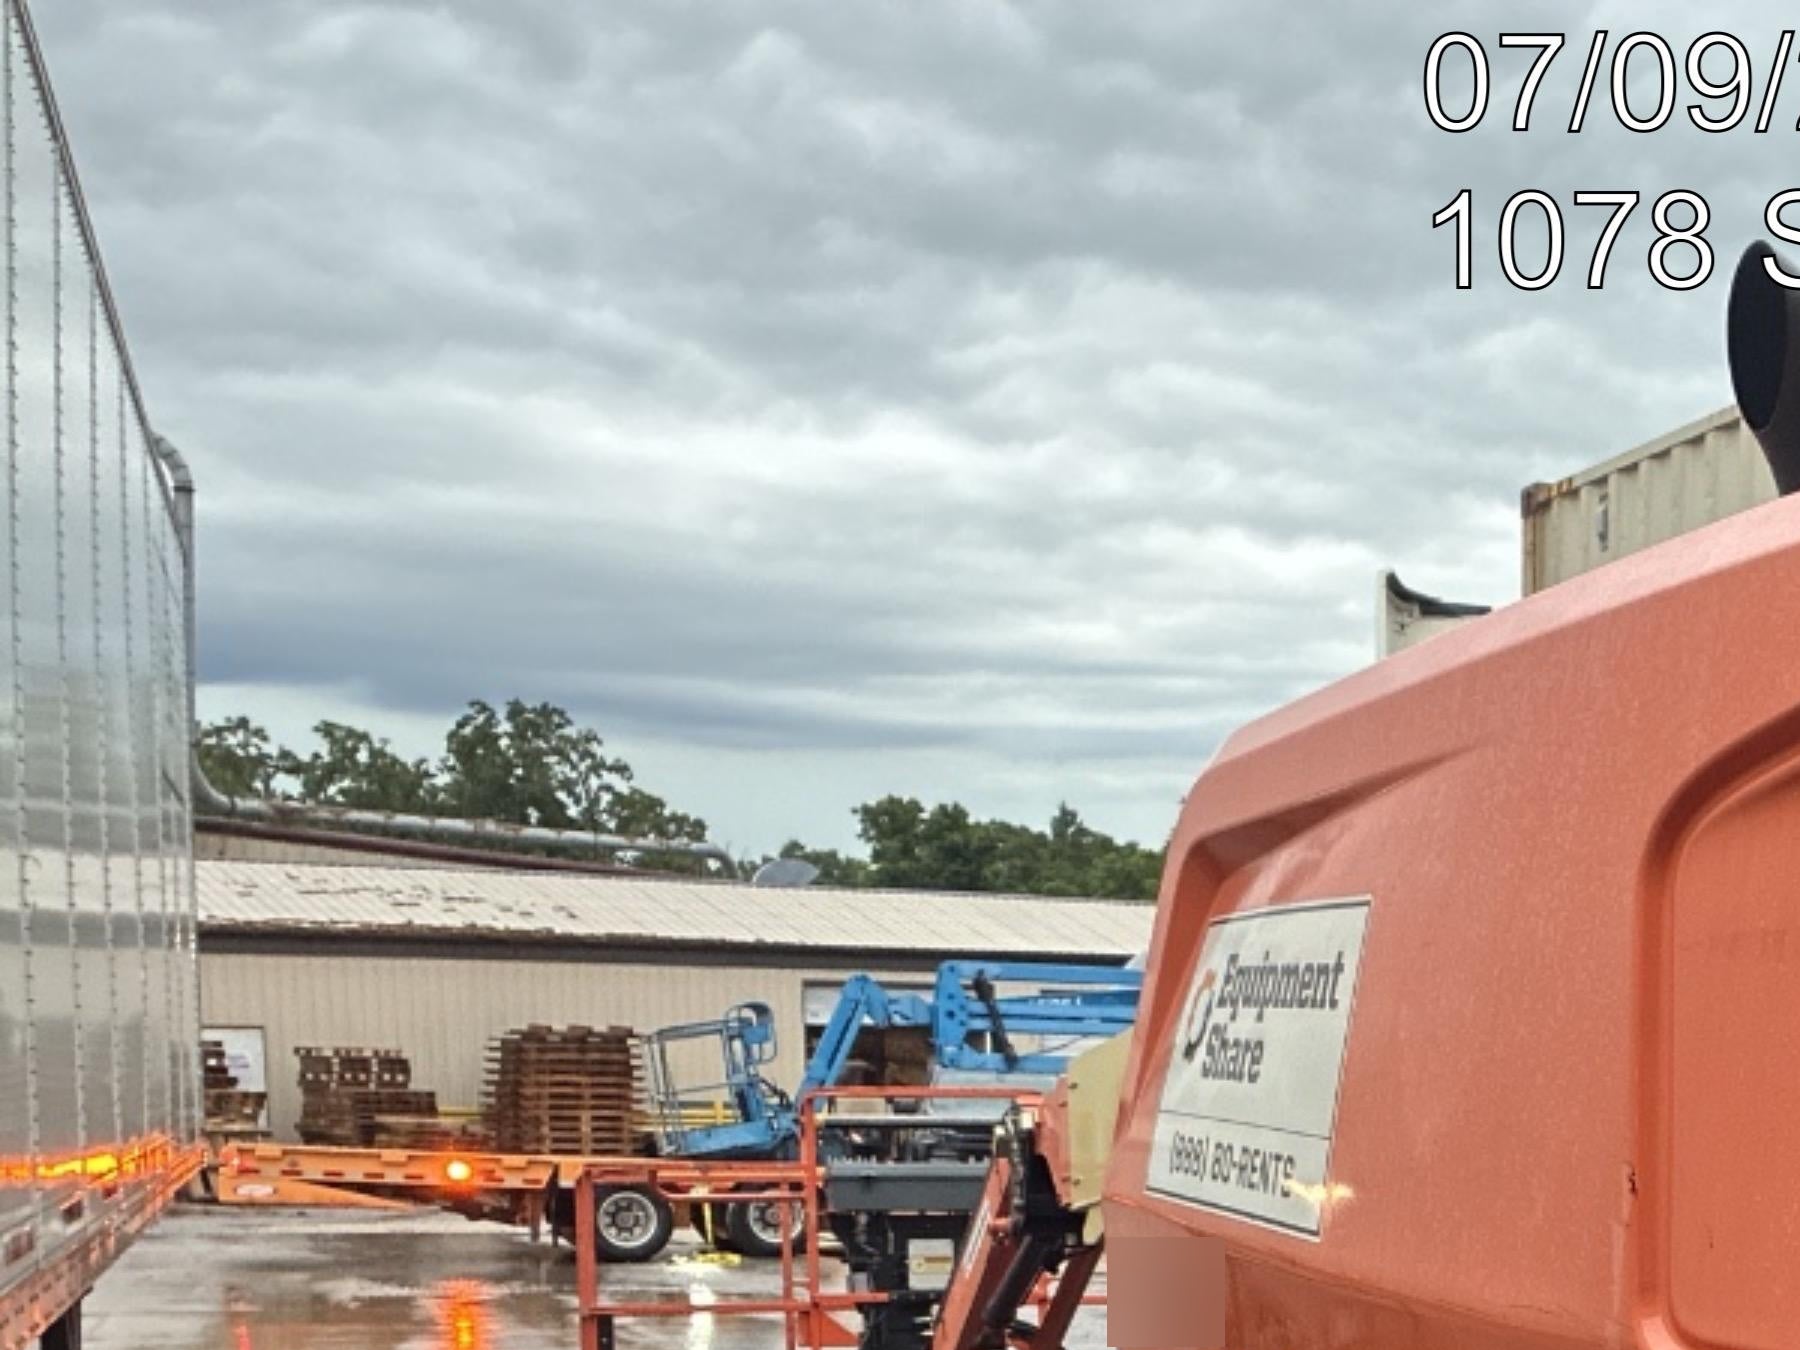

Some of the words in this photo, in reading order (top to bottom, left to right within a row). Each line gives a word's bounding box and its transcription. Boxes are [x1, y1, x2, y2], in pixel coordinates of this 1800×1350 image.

[1216, 950, 1345, 1022] Equipment
[1200, 1023, 1264, 1084] Share
[1168, 1131, 1207, 1183] (888)
[1211, 1142, 1297, 1199] 80-RENTS
